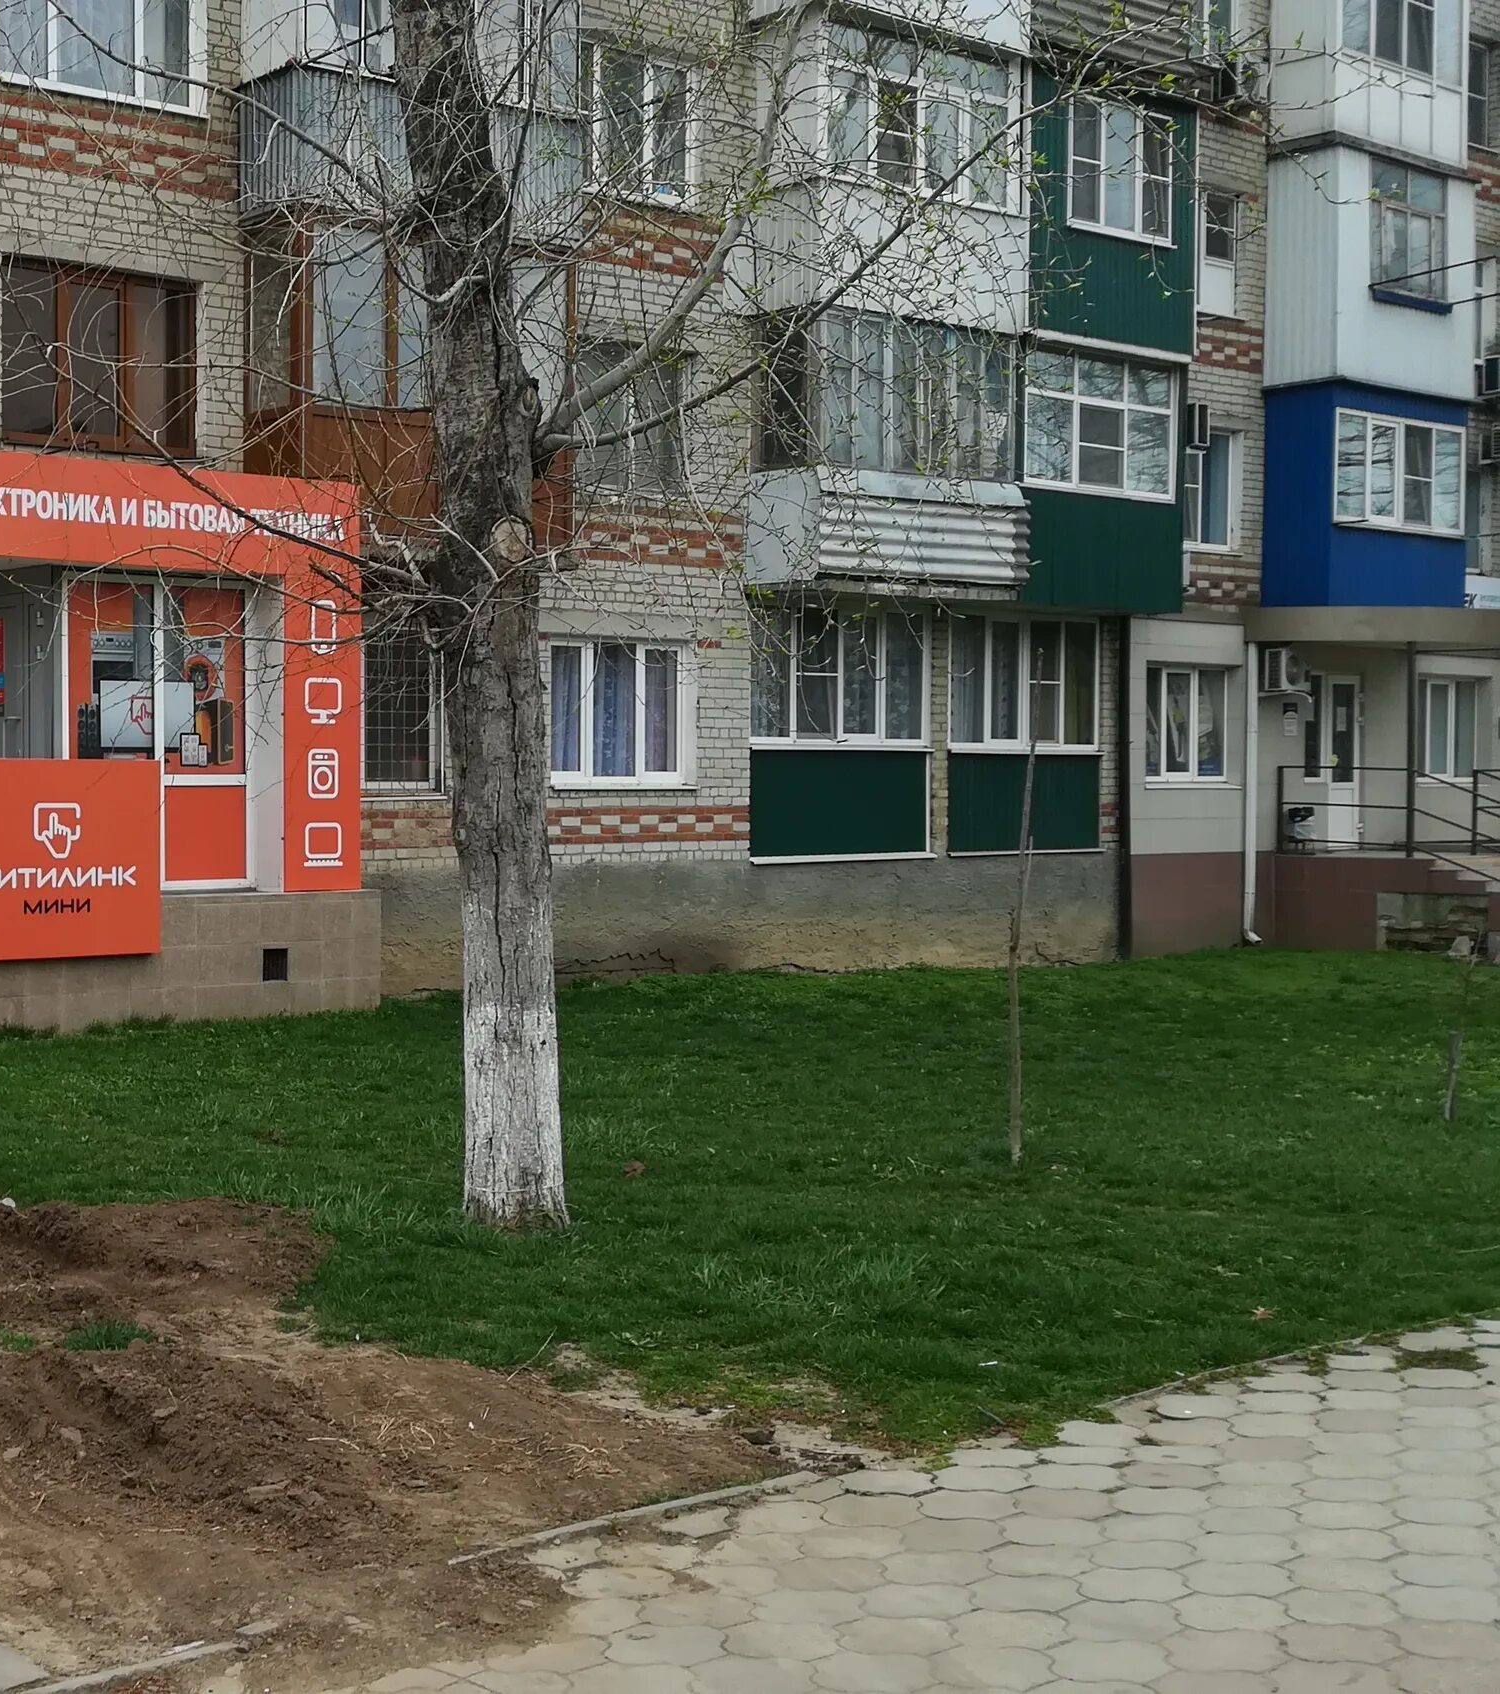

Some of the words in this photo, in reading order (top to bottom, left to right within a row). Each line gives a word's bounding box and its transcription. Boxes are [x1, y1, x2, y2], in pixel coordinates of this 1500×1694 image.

[121, 502, 138, 526] И
[143, 499, 246, 535] БЫТОВАЯ
[23, 898, 91, 915] МИНИ
